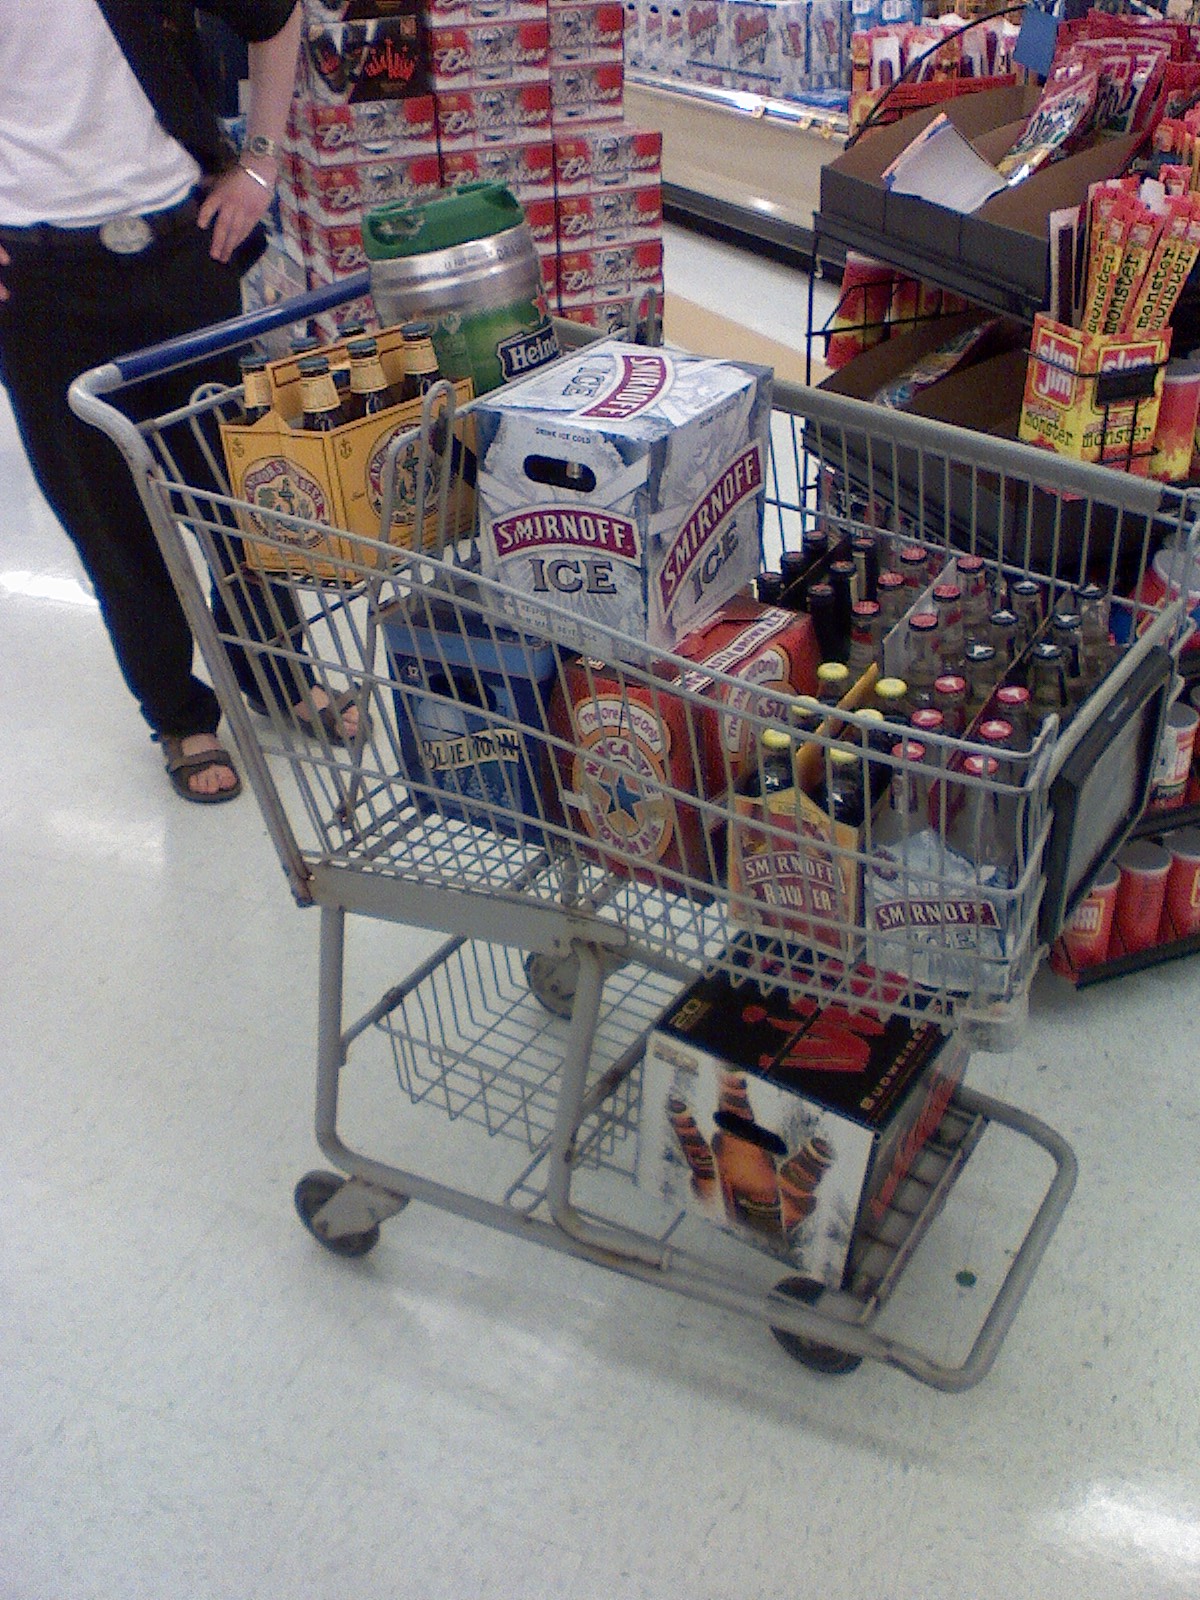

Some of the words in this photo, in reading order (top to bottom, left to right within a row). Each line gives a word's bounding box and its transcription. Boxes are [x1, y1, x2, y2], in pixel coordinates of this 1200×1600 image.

[558, 156, 661, 180] Budweiser
[560, 210, 660, 235] Budweiser
[562, 266, 660, 292] Budweiser
[1087, 254, 1116, 334] monster
[1104, 253, 1140, 335] monster
[1137, 247, 1175, 330] monster
[561, 366, 612, 398] ICE
[597, 356, 661, 419] SMIRNOFF
[1082, 426, 1151, 448] monster
[497, 511, 627, 550] SMIRNOFF
[662, 452, 756, 597] SMIRNOFF
[528, 558, 618, 595] ICE
[688, 520, 740, 604] ICE
[745, 854, 834, 883] SMRNOFF
[878, 902, 985, 927] SMRNOFF
